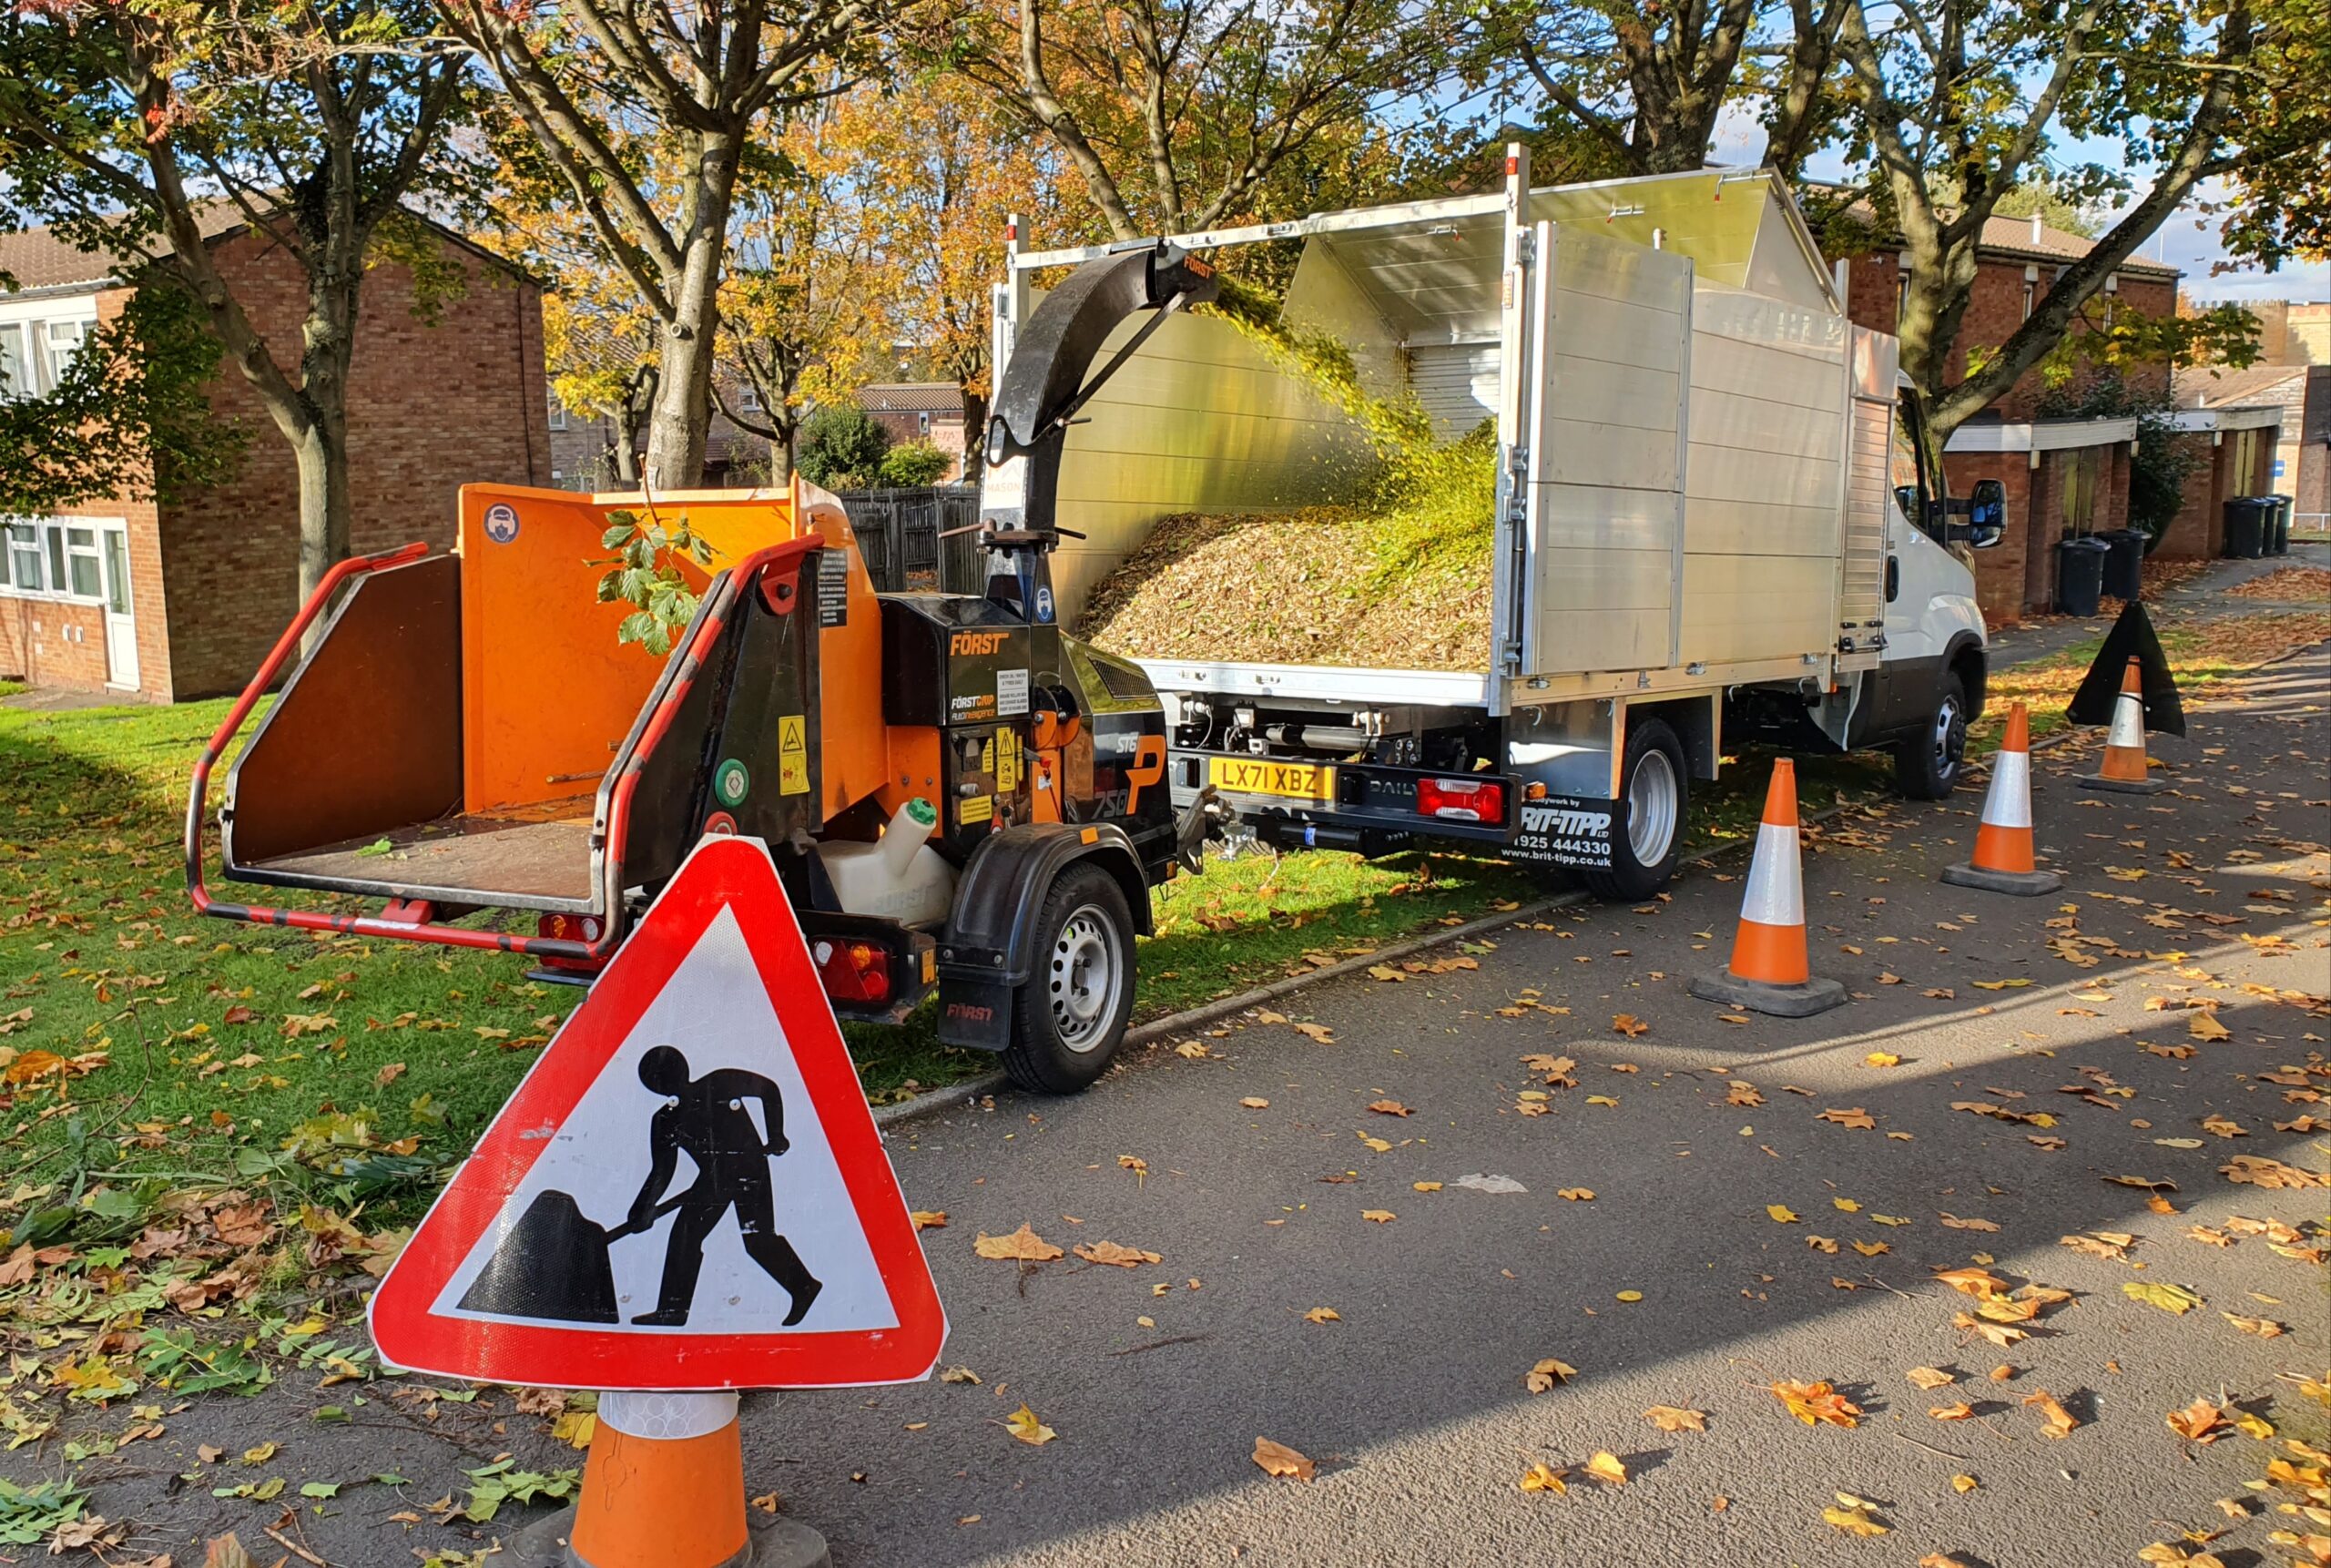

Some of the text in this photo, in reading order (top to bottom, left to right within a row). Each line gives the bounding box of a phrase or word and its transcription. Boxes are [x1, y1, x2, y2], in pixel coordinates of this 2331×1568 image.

[986, 482, 1021, 493] MASON
[950, 630, 1010, 657] FÖRST
[1222, 762, 1318, 794] LX71 XBZ
[1091, 789, 1129, 820] 750
[1570, 799, 1581, 808] by
[1521, 807, 1612, 837] RIT-TIPP
[1501, 849, 1612, 867] www.brit-tipp.co.uk
[1552, 839, 1611, 855] 444330
